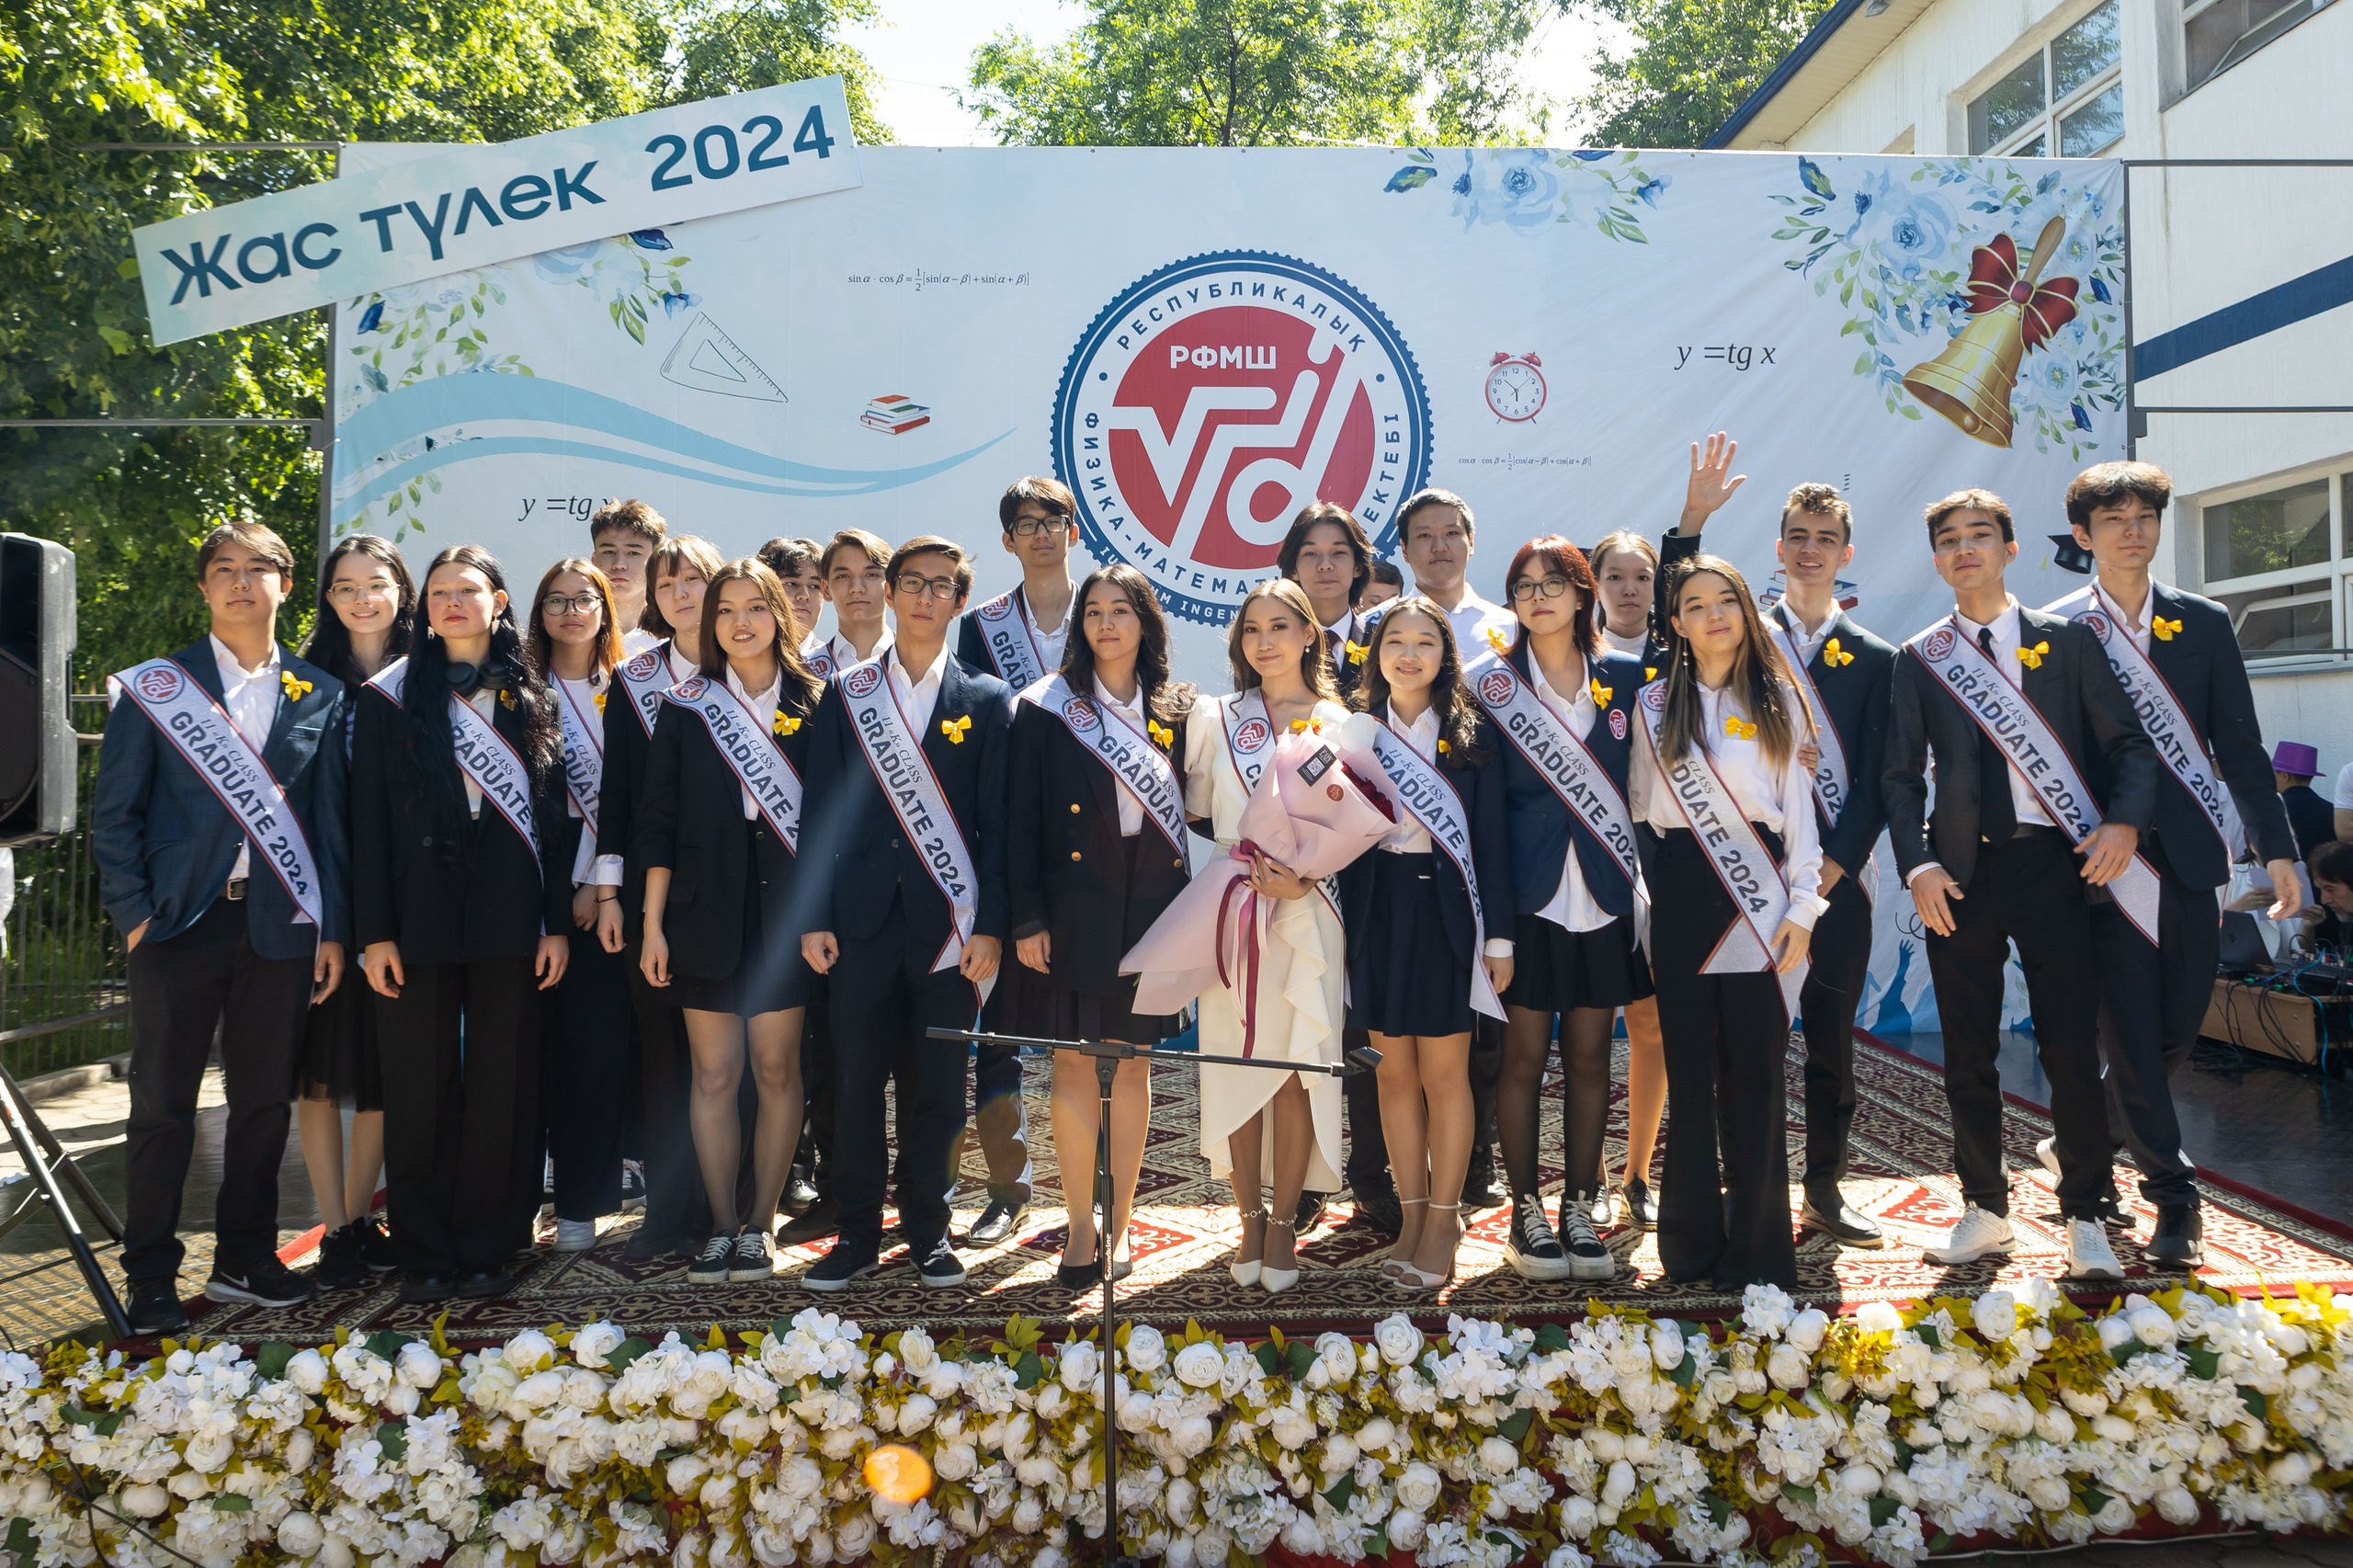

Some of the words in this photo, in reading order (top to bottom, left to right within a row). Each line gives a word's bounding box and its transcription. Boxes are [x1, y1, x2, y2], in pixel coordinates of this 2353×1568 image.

[160, 222, 343, 305] Жас
[643, 105, 835, 192] 2024
[847, 274, 862, 283] sin
[1170, 345, 1277, 369] РФМШ
[1674, 346, 1692, 370] y
[1760, 347, 1776, 365] x
[1362, 413, 1400, 534] ЕКТЕБІ
[517, 498, 536, 522] y
[993, 631, 1028, 690] GRAD
[1014, 640, 1024, 651] 11
[1971, 666, 1984, 679] 11
[1999, 695, 2029, 727] CLASS
[2127, 665, 2142, 677] 11
[2153, 695, 2177, 726] CLASS
[201, 718, 215, 730] 11
[229, 750, 260, 783] CLASS
[459, 719, 472, 729] 11
[486, 745, 517, 776] CLASS
[576, 741, 599, 776] CLASS
[704, 703, 794, 821] GRADUATE
[726, 709, 738, 721] 11
[750, 740, 777, 770] CLASS
[880, 716, 892, 729] 11
[899, 749, 923, 783] CLASS
[1124, 740, 1137, 751] 11
[1151, 767, 1176, 798] CLASS
[1508, 711, 1608, 826] GRADUATE
[1530, 716, 1545, 729] 11
[1560, 745, 1589, 776] CLASS
[1947, 664, 2050, 780] GRADUATE
[2041, 778, 2092, 839] 2024
[170, 711, 277, 836] GRADUATE
[268, 836, 308, 896] 2024
[452, 725, 532, 825] RADUATE
[859, 707, 934, 836] GRADUATE
[924, 837, 967, 899] 2024
[1098, 735, 1184, 847] GRADUATE
[1389, 748, 1398, 759] 11
[1415, 773, 1447, 801] CLASS
[1688, 760, 1715, 794] CLASS
[1814, 767, 1842, 814] 202
[2189, 773, 2224, 828] 2024
[1671, 763, 1730, 847] DUATE
[1720, 850, 1769, 914] 2024
[1461, 853, 1482, 918] 2024
